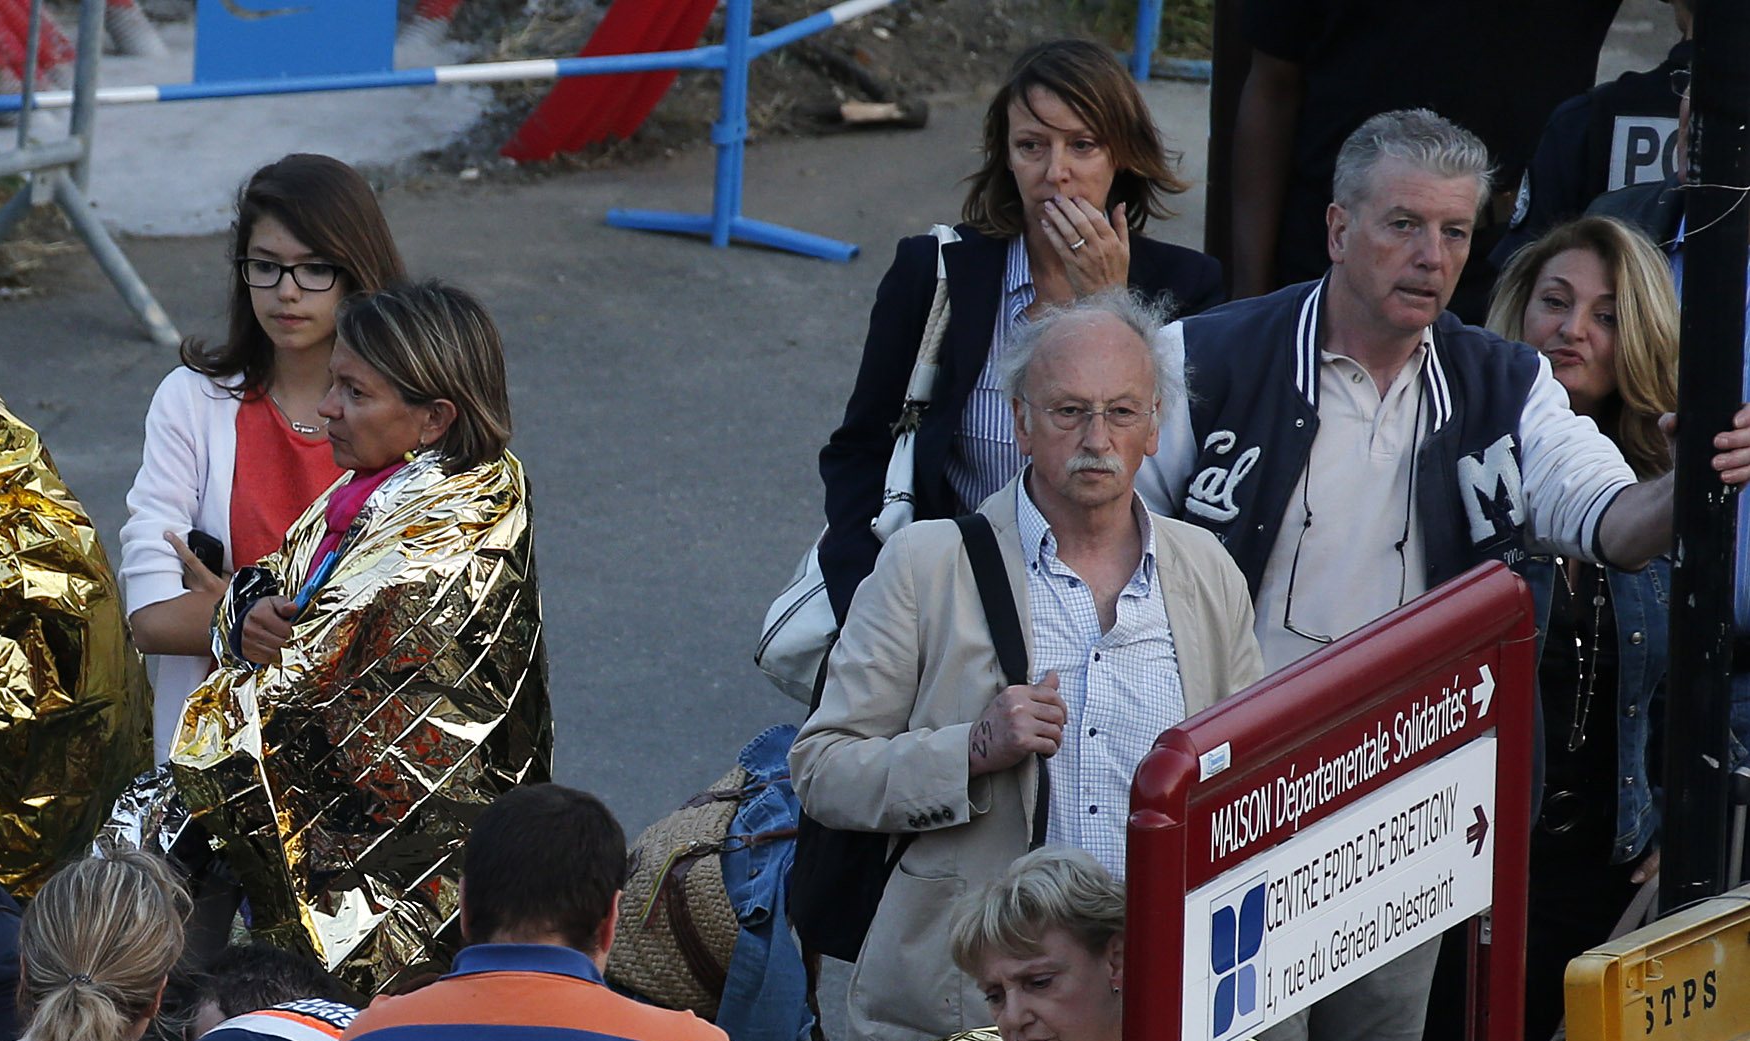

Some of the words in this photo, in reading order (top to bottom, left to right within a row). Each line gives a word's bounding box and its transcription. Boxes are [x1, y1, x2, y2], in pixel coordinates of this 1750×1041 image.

[1457, 433, 1526, 544] M
[1211, 783, 1272, 863] MAISON
[1276, 722, 1390, 832] Départementale
[1393, 675, 1467, 764] Solidarités
[1266, 858, 1320, 933] CENTRE
[1323, 834, 1364, 901] EPIDE
[1367, 822, 1387, 878] DE
[1390, 782, 1459, 866] BRETIGNY
[1267, 967, 1278, 1015] 1,
[1283, 958, 1305, 1000] rue
[1309, 940, 1326, 985] du
[1330, 912, 1380, 973] Général
[1384, 869, 1455, 943] Delestraint
